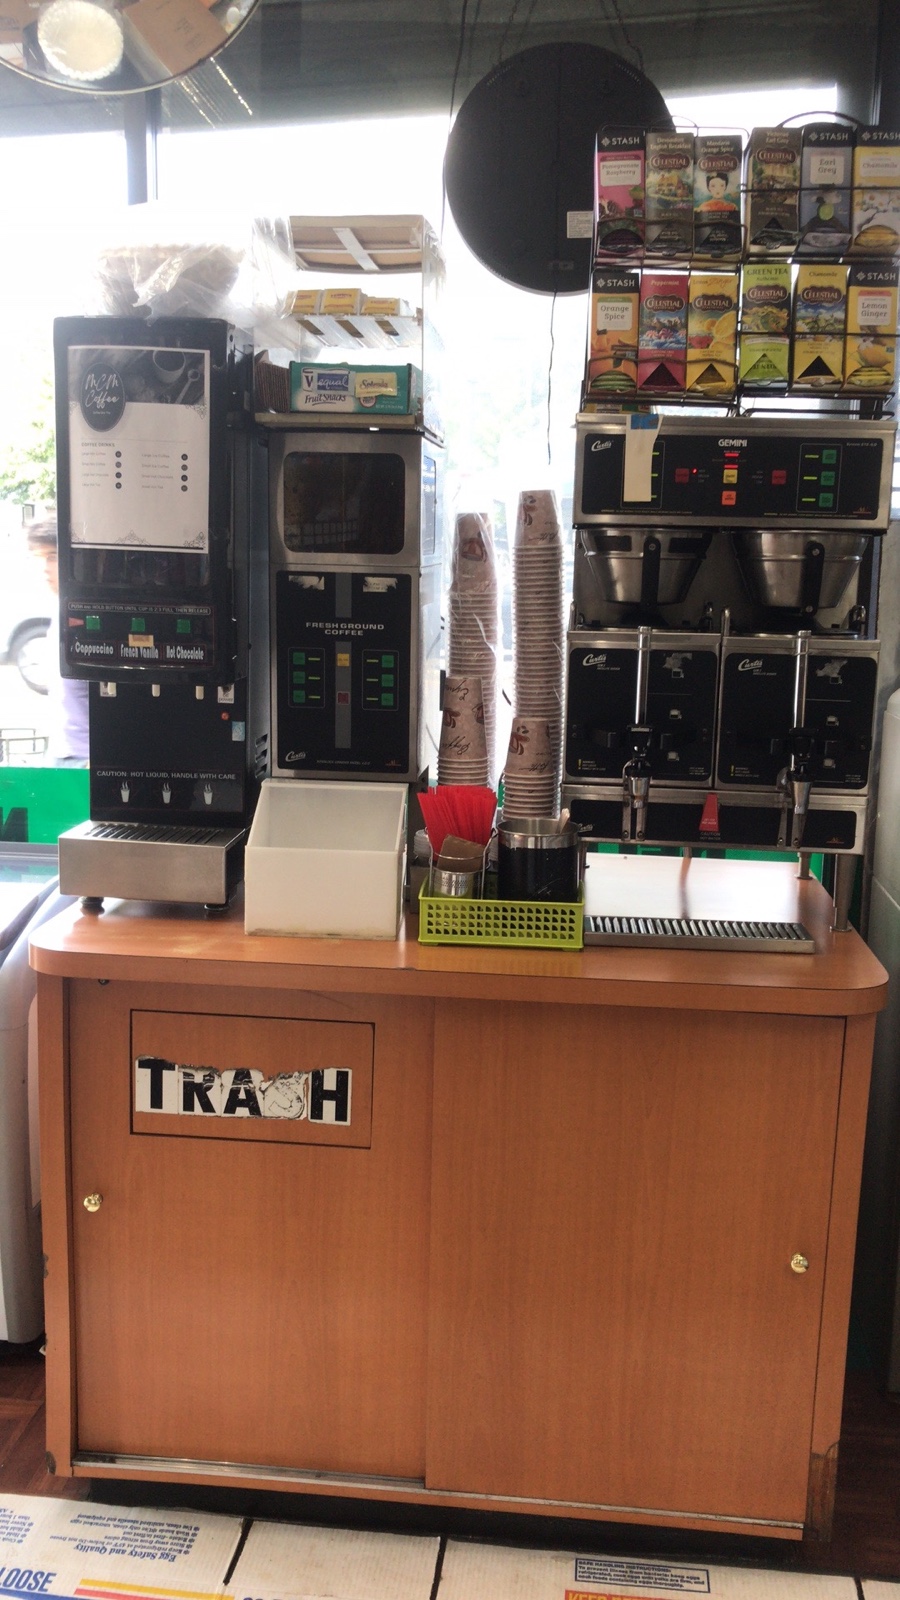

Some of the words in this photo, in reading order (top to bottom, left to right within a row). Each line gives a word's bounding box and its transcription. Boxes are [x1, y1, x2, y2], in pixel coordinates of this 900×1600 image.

[820, 132, 848, 140] STASH
[612, 137, 640, 146] STASH
[652, 156, 687, 166] CELESTIAL
[820, 158, 836, 166] Earl
[606, 169, 636, 177] Raspberry
[818, 166, 837, 174] Grey
[866, 272, 896, 280] STASH
[606, 279, 635, 287] STASH
[650, 279, 680, 287] Peppermint
[749, 289, 785, 298] CELESTIAL
[804, 290, 838, 299] CELESTIAL
[646, 298, 681, 308] CELESTIAL
[695, 298, 730, 307] CELESTIAL
[600, 305, 630, 314] Orange
[861, 310, 888, 318] Ginger
[318, 375, 348, 390] equal
[85, 390, 120, 408] Coffee
[304, 394, 324, 404] Fruit
[718, 438, 748, 448] GEMINI
[75, 641, 114, 656] Cappuccino
[140, 646, 159, 659] Vanilla
[166, 645, 176, 659] Hot
[176, 646, 204, 660] Chocolate
[582, 654, 607, 666] Curtis
[738, 658, 763, 672] Curtis
[285, 750, 306, 762] Curtis
[74, 1543, 108, 1554] Quality
[108, 1547, 127, 1555] and
[128, 1548, 158, 1560] Safety
[158, 1552, 177, 1562] Egg
